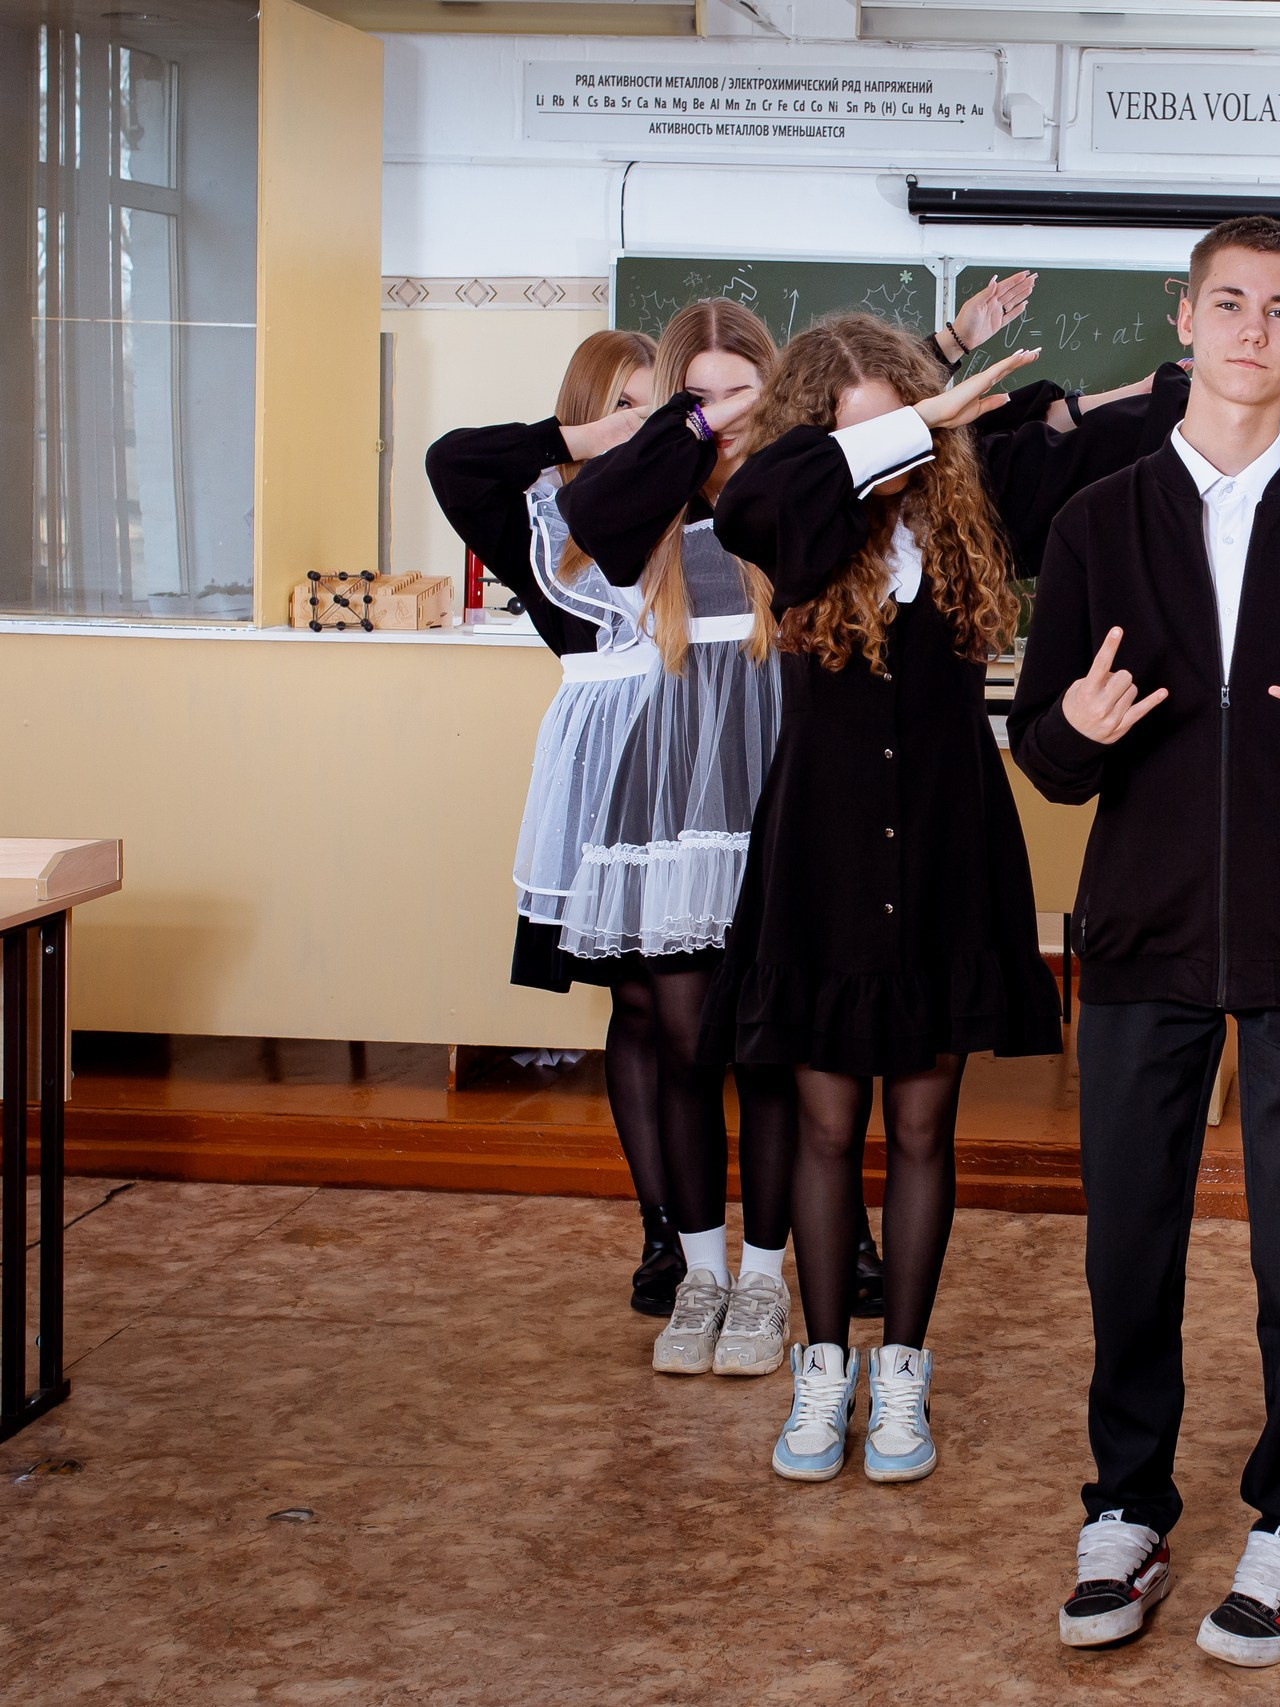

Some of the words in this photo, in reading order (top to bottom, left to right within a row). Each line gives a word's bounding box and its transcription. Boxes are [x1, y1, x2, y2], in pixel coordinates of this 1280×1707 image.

[575, 74, 596, 89] РЯД
[598, 75, 663, 88] АКТИВНОСТИ
[665, 77, 719, 90] МЕТАЛЛОВ
[729, 77, 839, 92] ЭЛЕКТРОХИМИЧЕСКИЙ
[841, 80, 862, 94] РЯД
[864, 80, 933, 93] НАПРЯЖЕНИЙ
[537, 94, 544, 106] Li
[553, 95, 564, 106] Rb
[573, 95, 579, 107] K
[588, 96, 598, 107] Cs
[604, 96, 615, 107] Ba
[622, 96, 631, 108] Sr
[637, 97, 648, 108] Ca
[655, 97, 667, 108] Na
[673, 98, 687, 112] Mg
[693, 98, 704, 109] Be
[710, 98, 719, 110] Al
[725, 99, 739, 110] Mn
[745, 99, 756, 110] Zn
[762, 99, 772, 111] Cr
[778, 100, 787, 111] Fe
[793, 100, 805, 111] Cd
[811, 100, 822, 112] Co
[829, 101, 838, 112] Ni
[847, 101, 858, 113] Sn
[864, 102, 876, 113] Pb
[882, 101, 896, 116] (H)
[902, 102, 913, 114] Cu
[919, 103, 932, 117] Hg
[937, 103, 950, 118] Ag
[956, 104, 966, 115] Pt
[971, 104, 983, 115] Au
[1106, 91, 1198, 121] VERBA
[648, 122, 713, 135] АКТИВНОСТЬ
[716, 123, 770, 137] МЕТАЛЛОВ
[772, 125, 845, 138] УМЕНЬШАЕТСЯ
